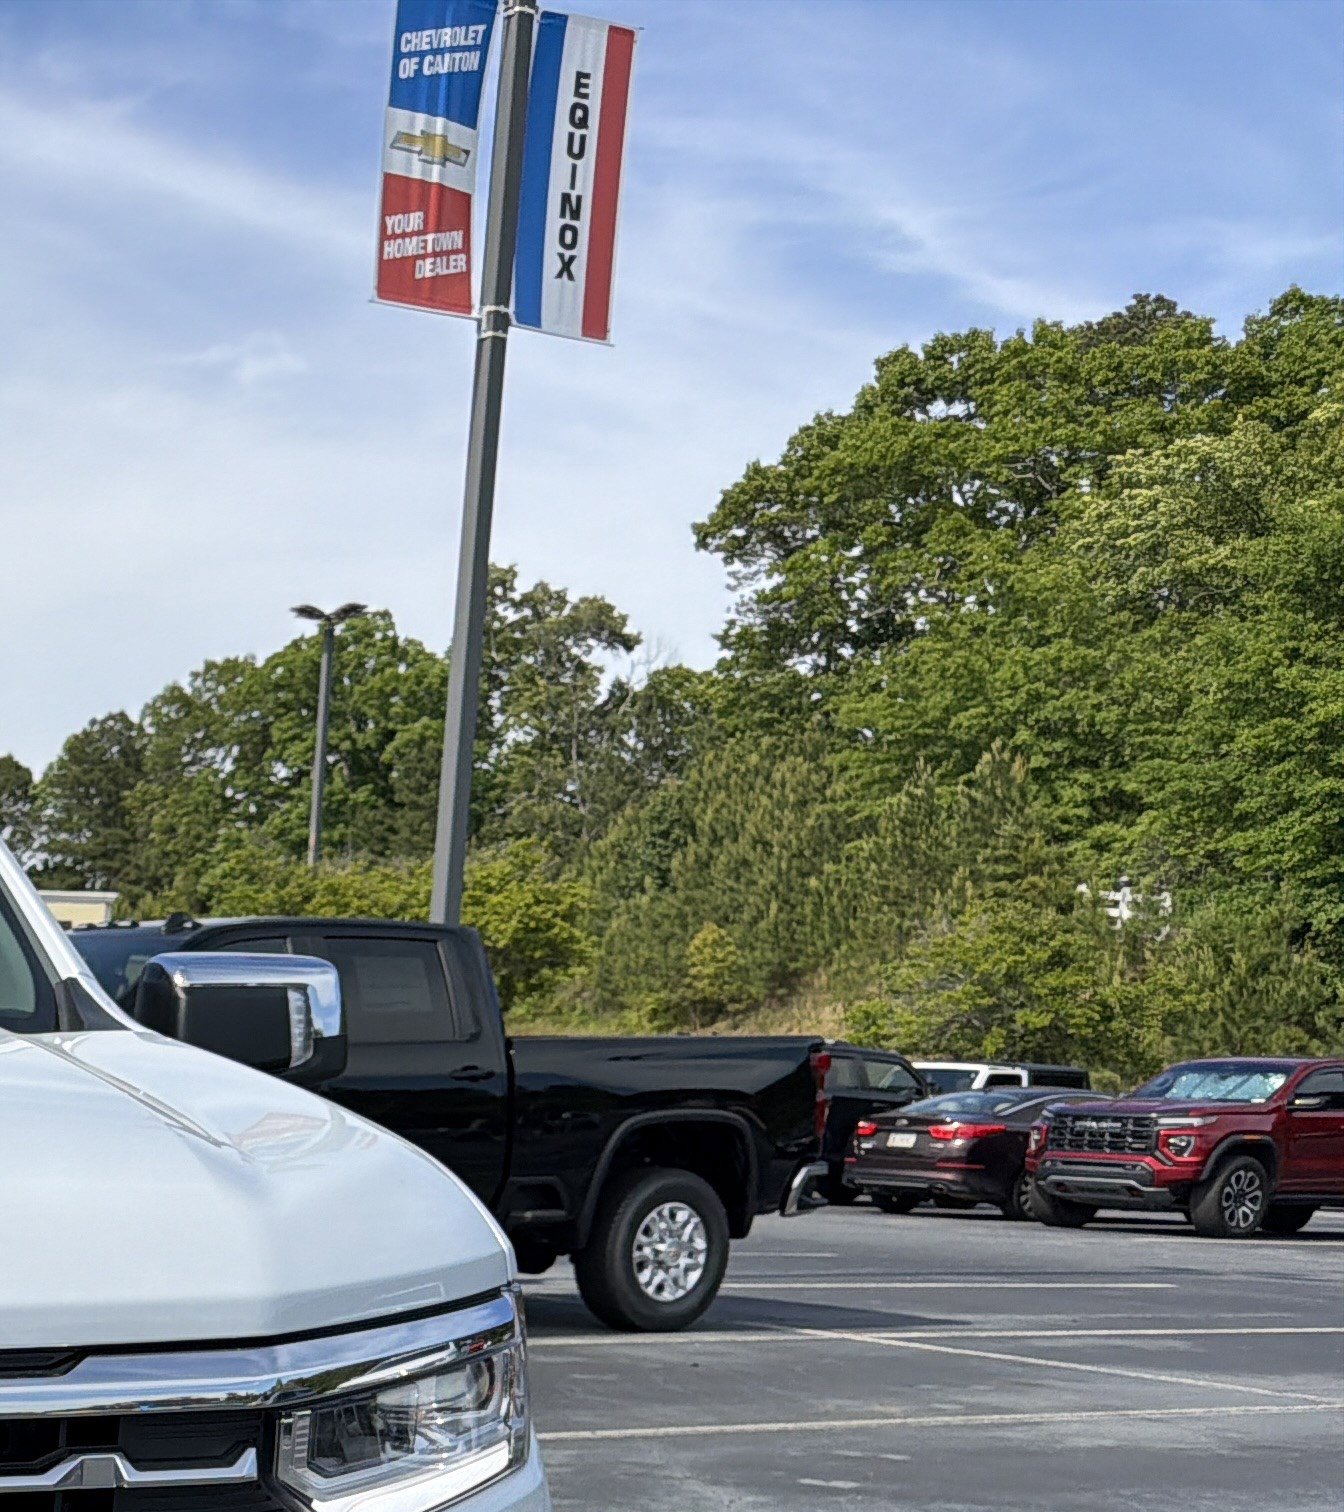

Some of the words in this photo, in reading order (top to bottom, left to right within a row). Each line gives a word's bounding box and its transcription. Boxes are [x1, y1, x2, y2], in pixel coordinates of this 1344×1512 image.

[400, 24, 487, 53] CHEVROLET
[398, 57, 420, 79] OF
[422, 50, 481, 76] CANTON
[555, 70, 592, 282] EQUINOX
[384, 211, 424, 236] YOUR
[383, 229, 464, 260] HOMETOWN
[414, 253, 467, 280] DEALER
